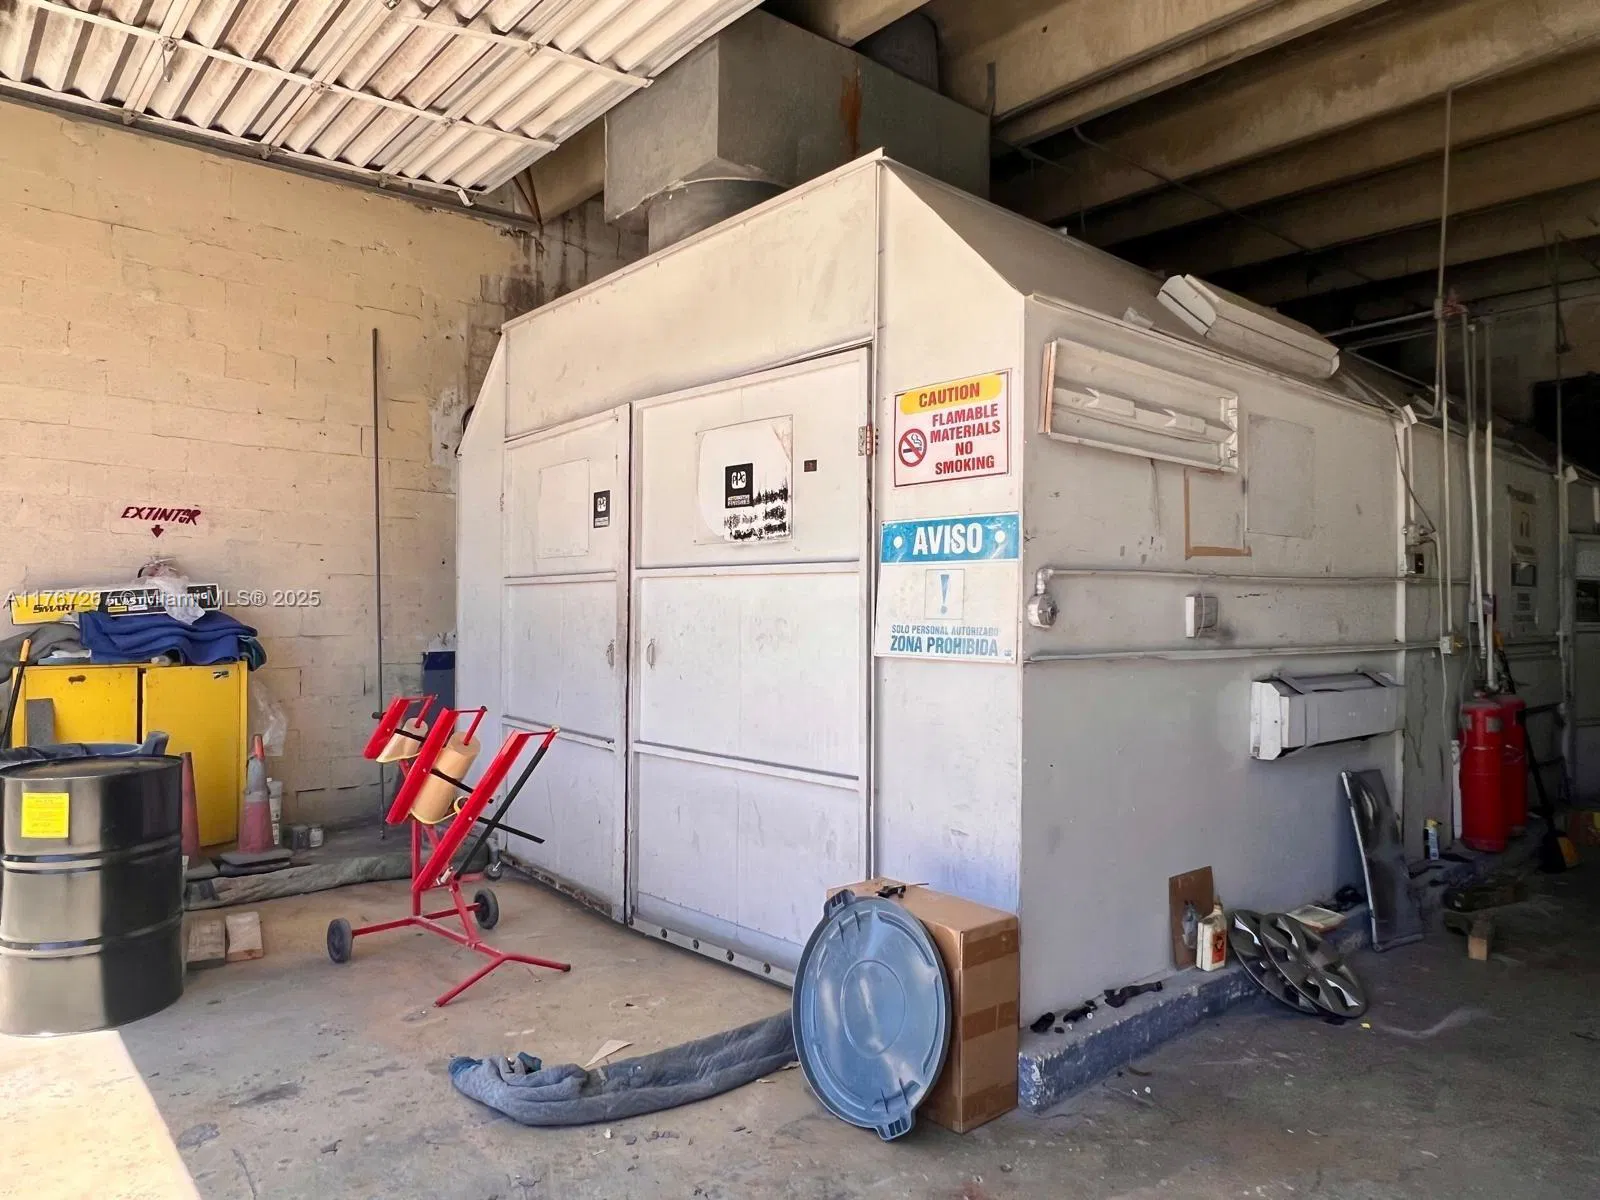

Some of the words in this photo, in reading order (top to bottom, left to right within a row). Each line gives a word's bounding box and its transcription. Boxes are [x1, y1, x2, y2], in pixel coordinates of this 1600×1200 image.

[919, 382, 980, 408] CAUTION
[932, 403, 998, 427] FLAMABLE
[930, 420, 1000, 443] MATERIALS
[955, 441, 973, 456] NO
[935, 455, 994, 475] SMOKING
[913, 523, 982, 555] AVISO
[33, 603, 78, 613] SMART
[892, 624, 909, 634] SOLO
[912, 625, 949, 635] PERSONAL
[951, 626, 999, 637] AUTORIZADO
[890, 635, 922, 652] ZONA
[927, 637, 999, 656] PROHIBIDA
